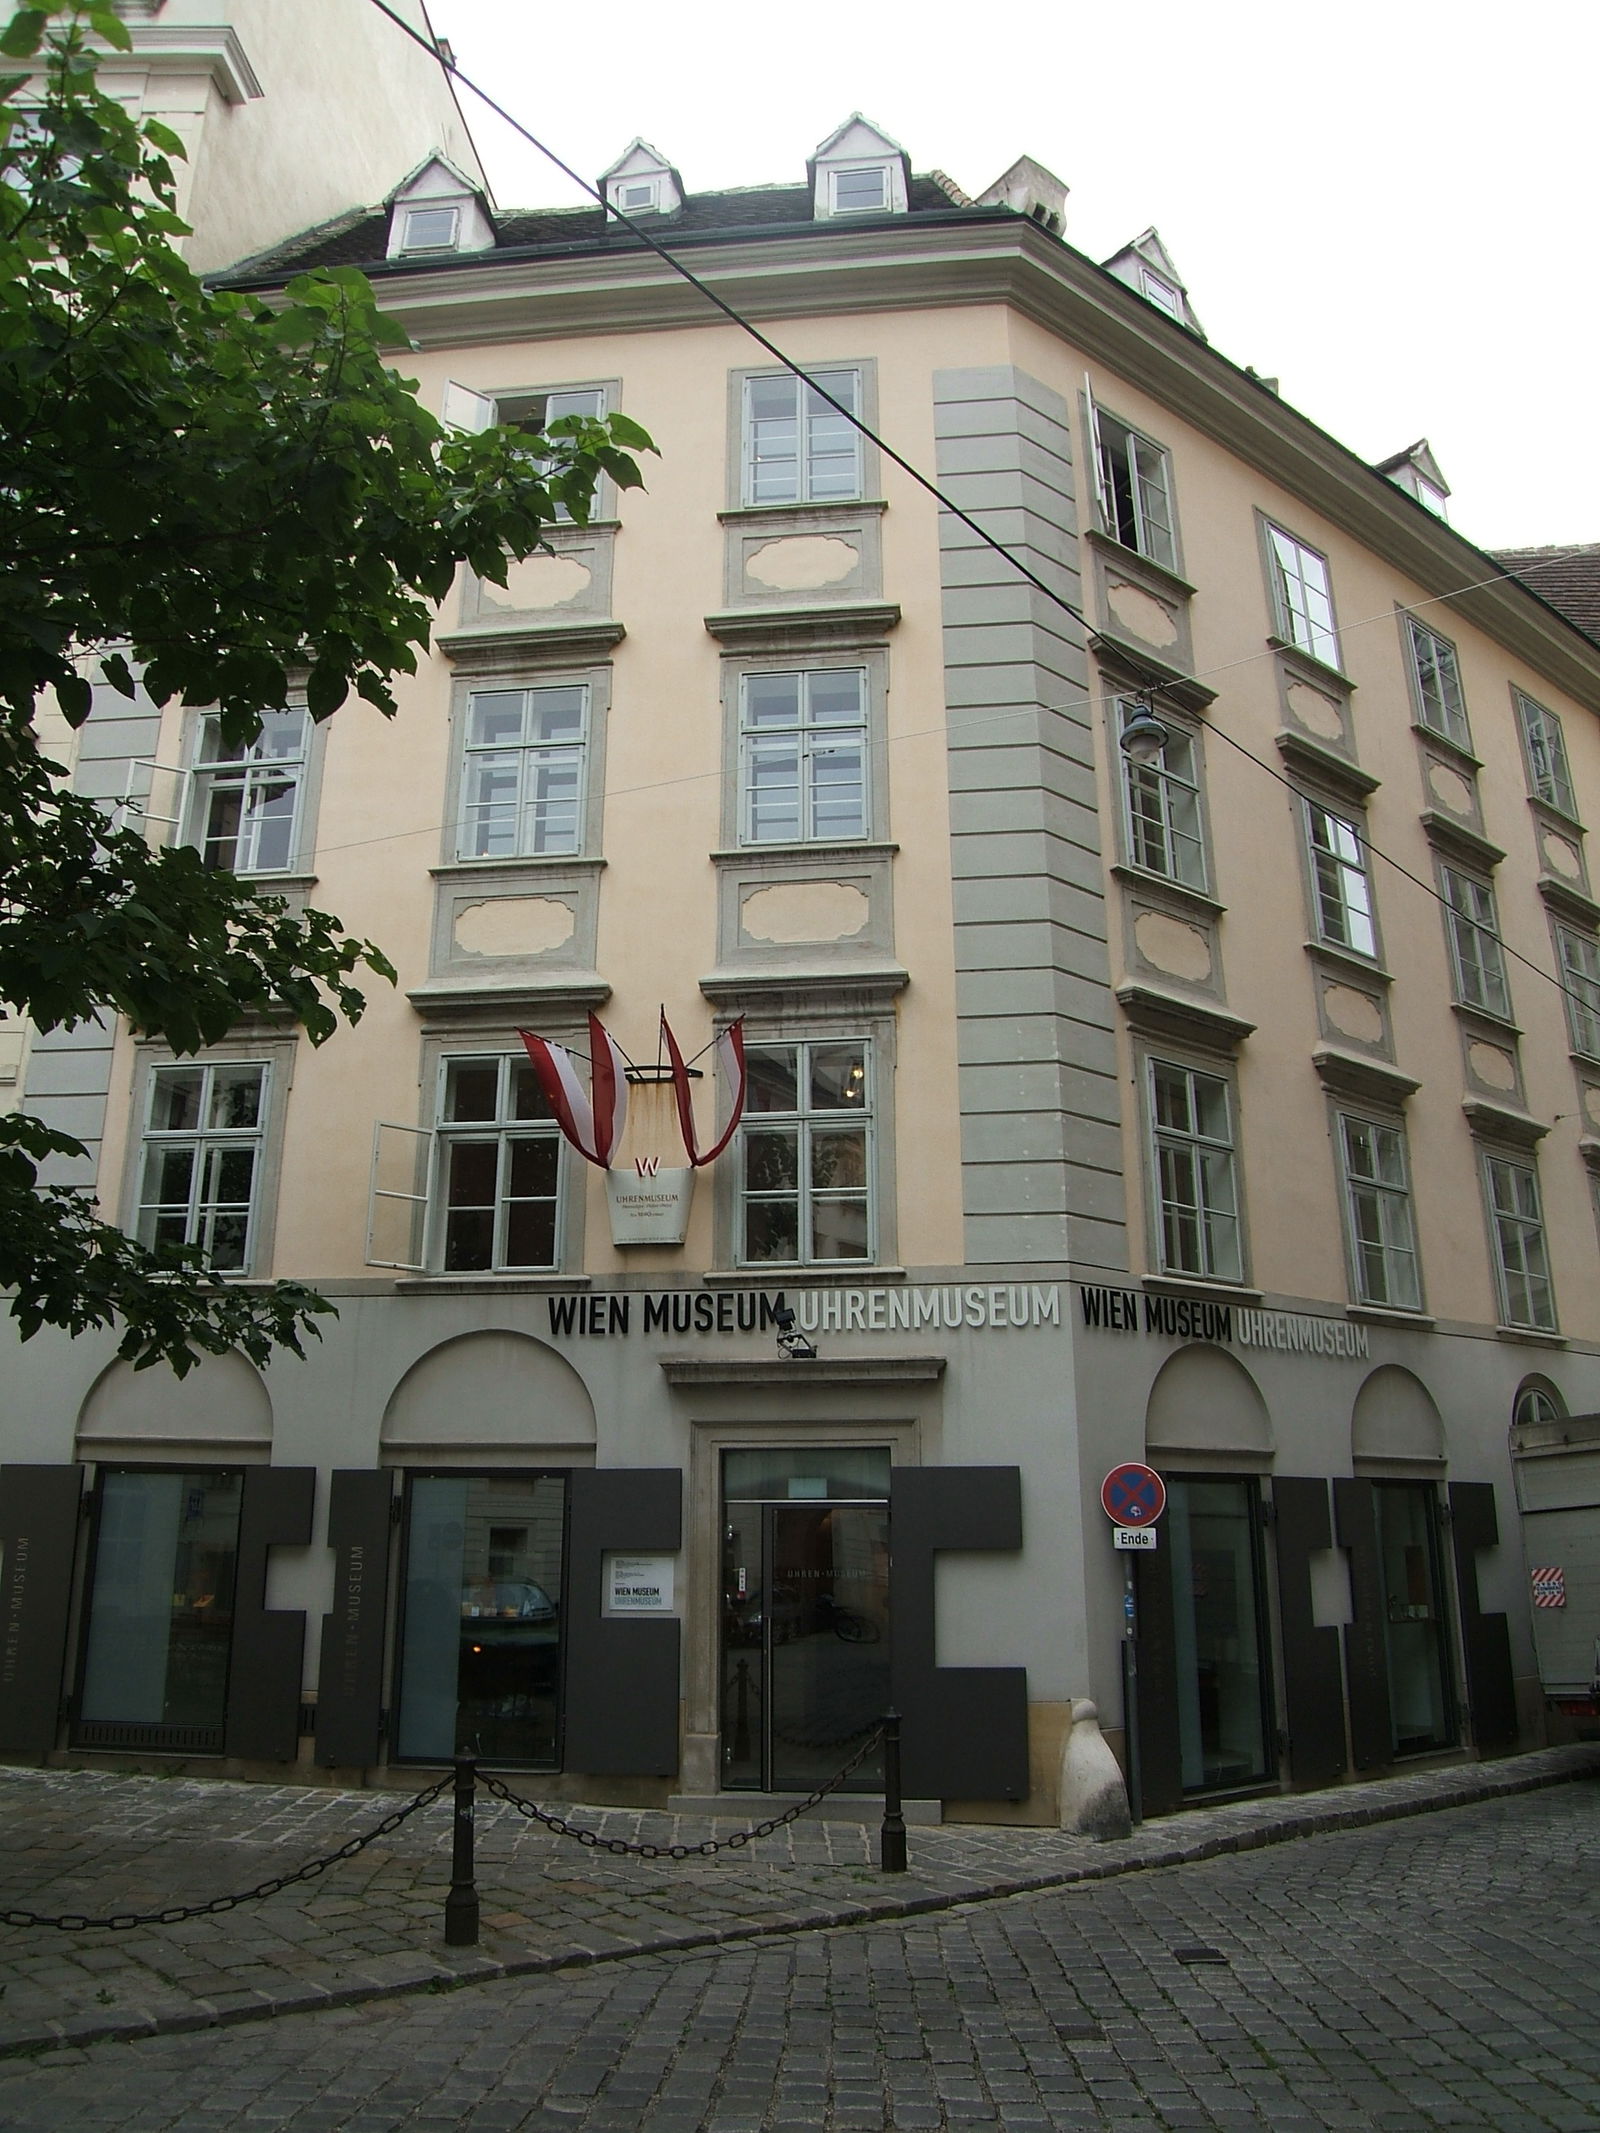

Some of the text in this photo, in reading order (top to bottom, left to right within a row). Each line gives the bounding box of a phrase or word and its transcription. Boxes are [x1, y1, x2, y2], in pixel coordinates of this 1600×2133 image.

[616, 1194, 679, 1203] UHRENMUSEUM
[549, 1285, 1061, 1335] WIEN MUSEUM UHRENMUSEUM
[1080, 1286, 1370, 1359] WIEN MUSEUM UHRENMUSEUM
[1121, 1532, 1149, 1545] Ende
[615, 1587, 660, 1596] WIEN MUSEUM
